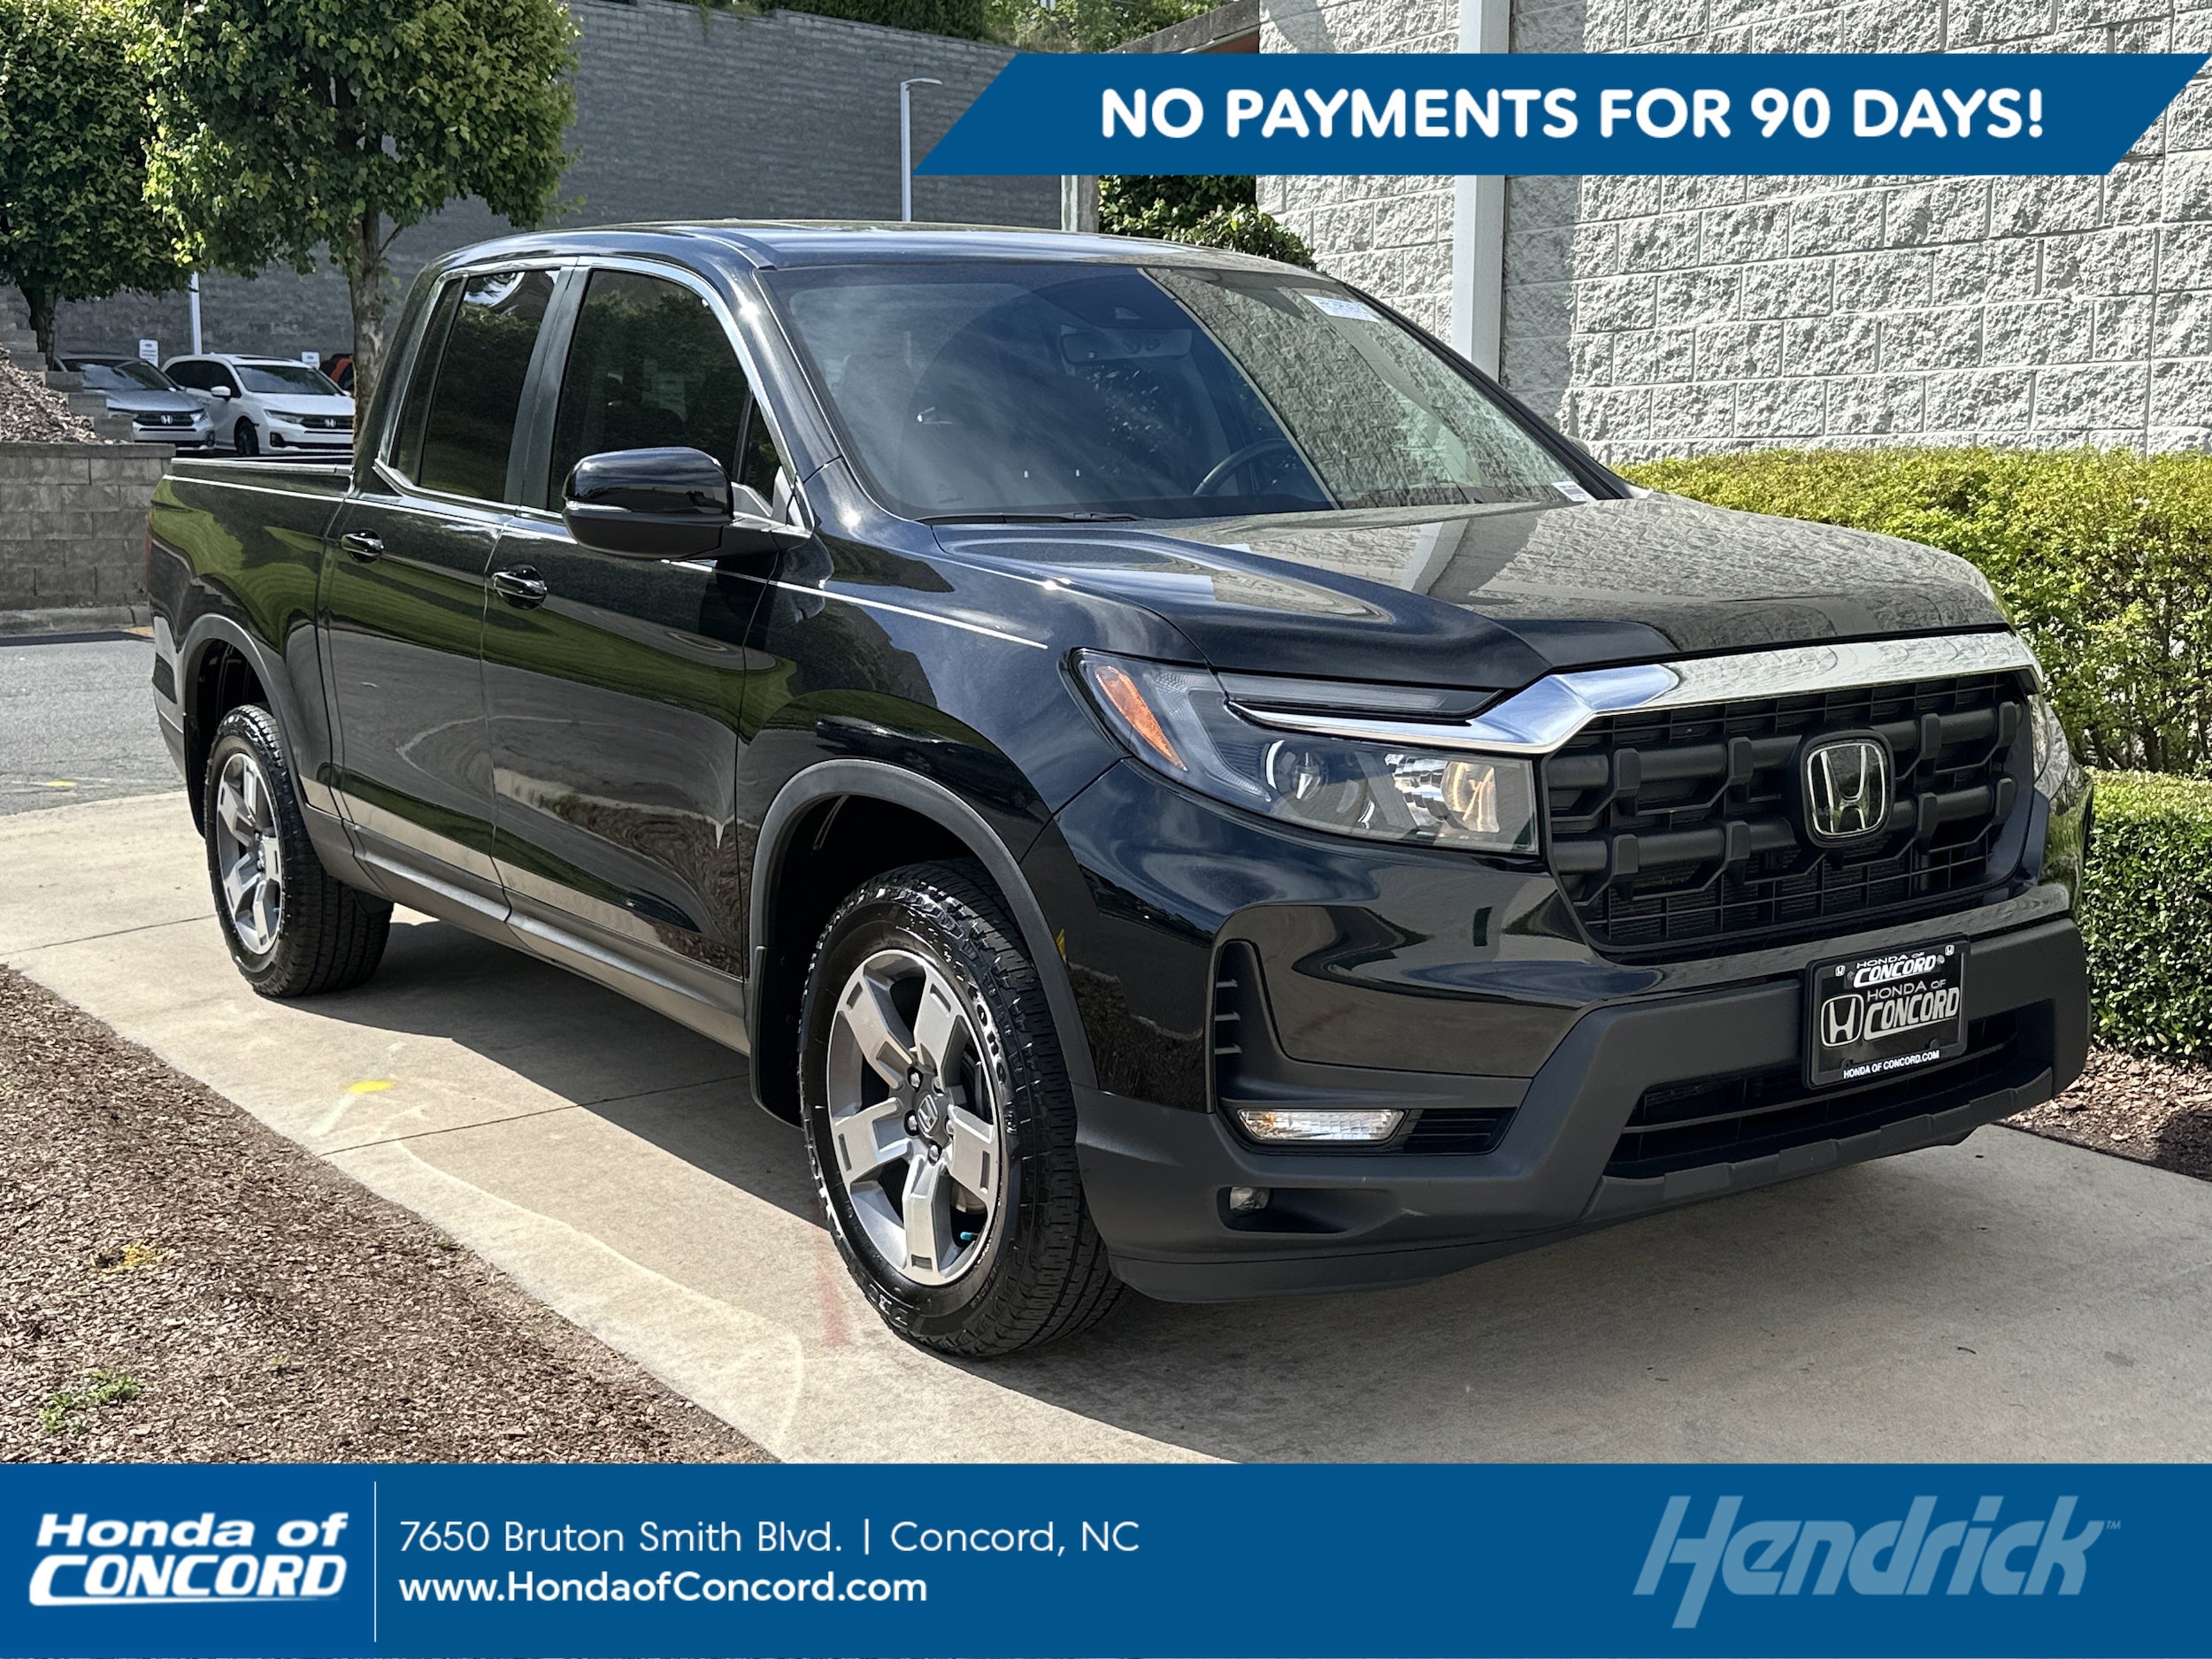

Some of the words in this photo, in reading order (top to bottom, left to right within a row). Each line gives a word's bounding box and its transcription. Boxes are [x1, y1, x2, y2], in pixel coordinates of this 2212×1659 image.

[1854, 955, 1937, 988] CONCORD
[1856, 954, 1909, 970] HONDA
[1867, 979, 1927, 1002] HONDA
[1931, 979, 1947, 989] OF
[1863, 987, 1961, 1041] CONCORD
[1843, 1064, 1870, 1079] HONDA
[1871, 1063, 1883, 1072] OF
[1883, 1049, 1940, 1071] CONCORD.COM
